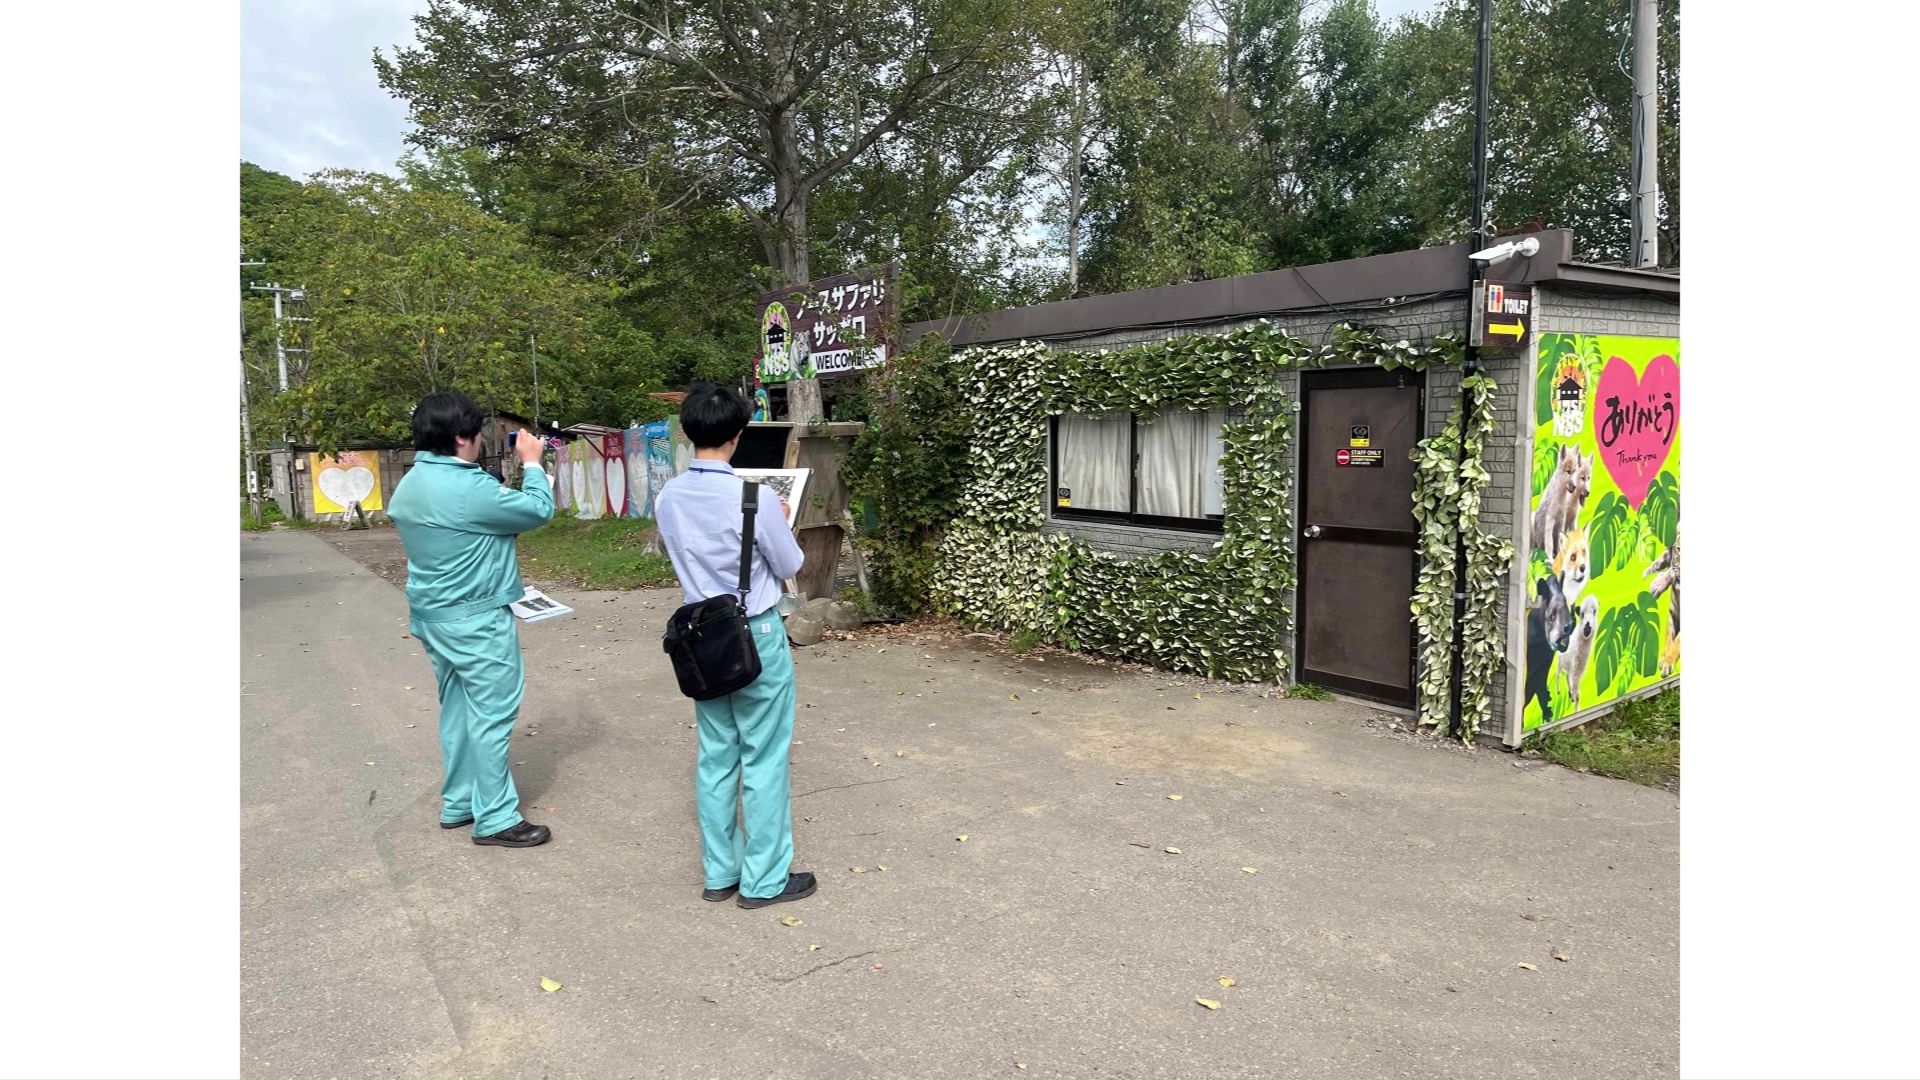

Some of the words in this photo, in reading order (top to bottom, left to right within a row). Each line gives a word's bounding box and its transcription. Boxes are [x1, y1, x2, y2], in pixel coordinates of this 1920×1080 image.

[1504, 298, 1529, 315] TOILET
[1601, 392, 1674, 448] ありがとう
[1616, 449, 1642, 467] Thank
[1643, 453, 1657, 466] you
